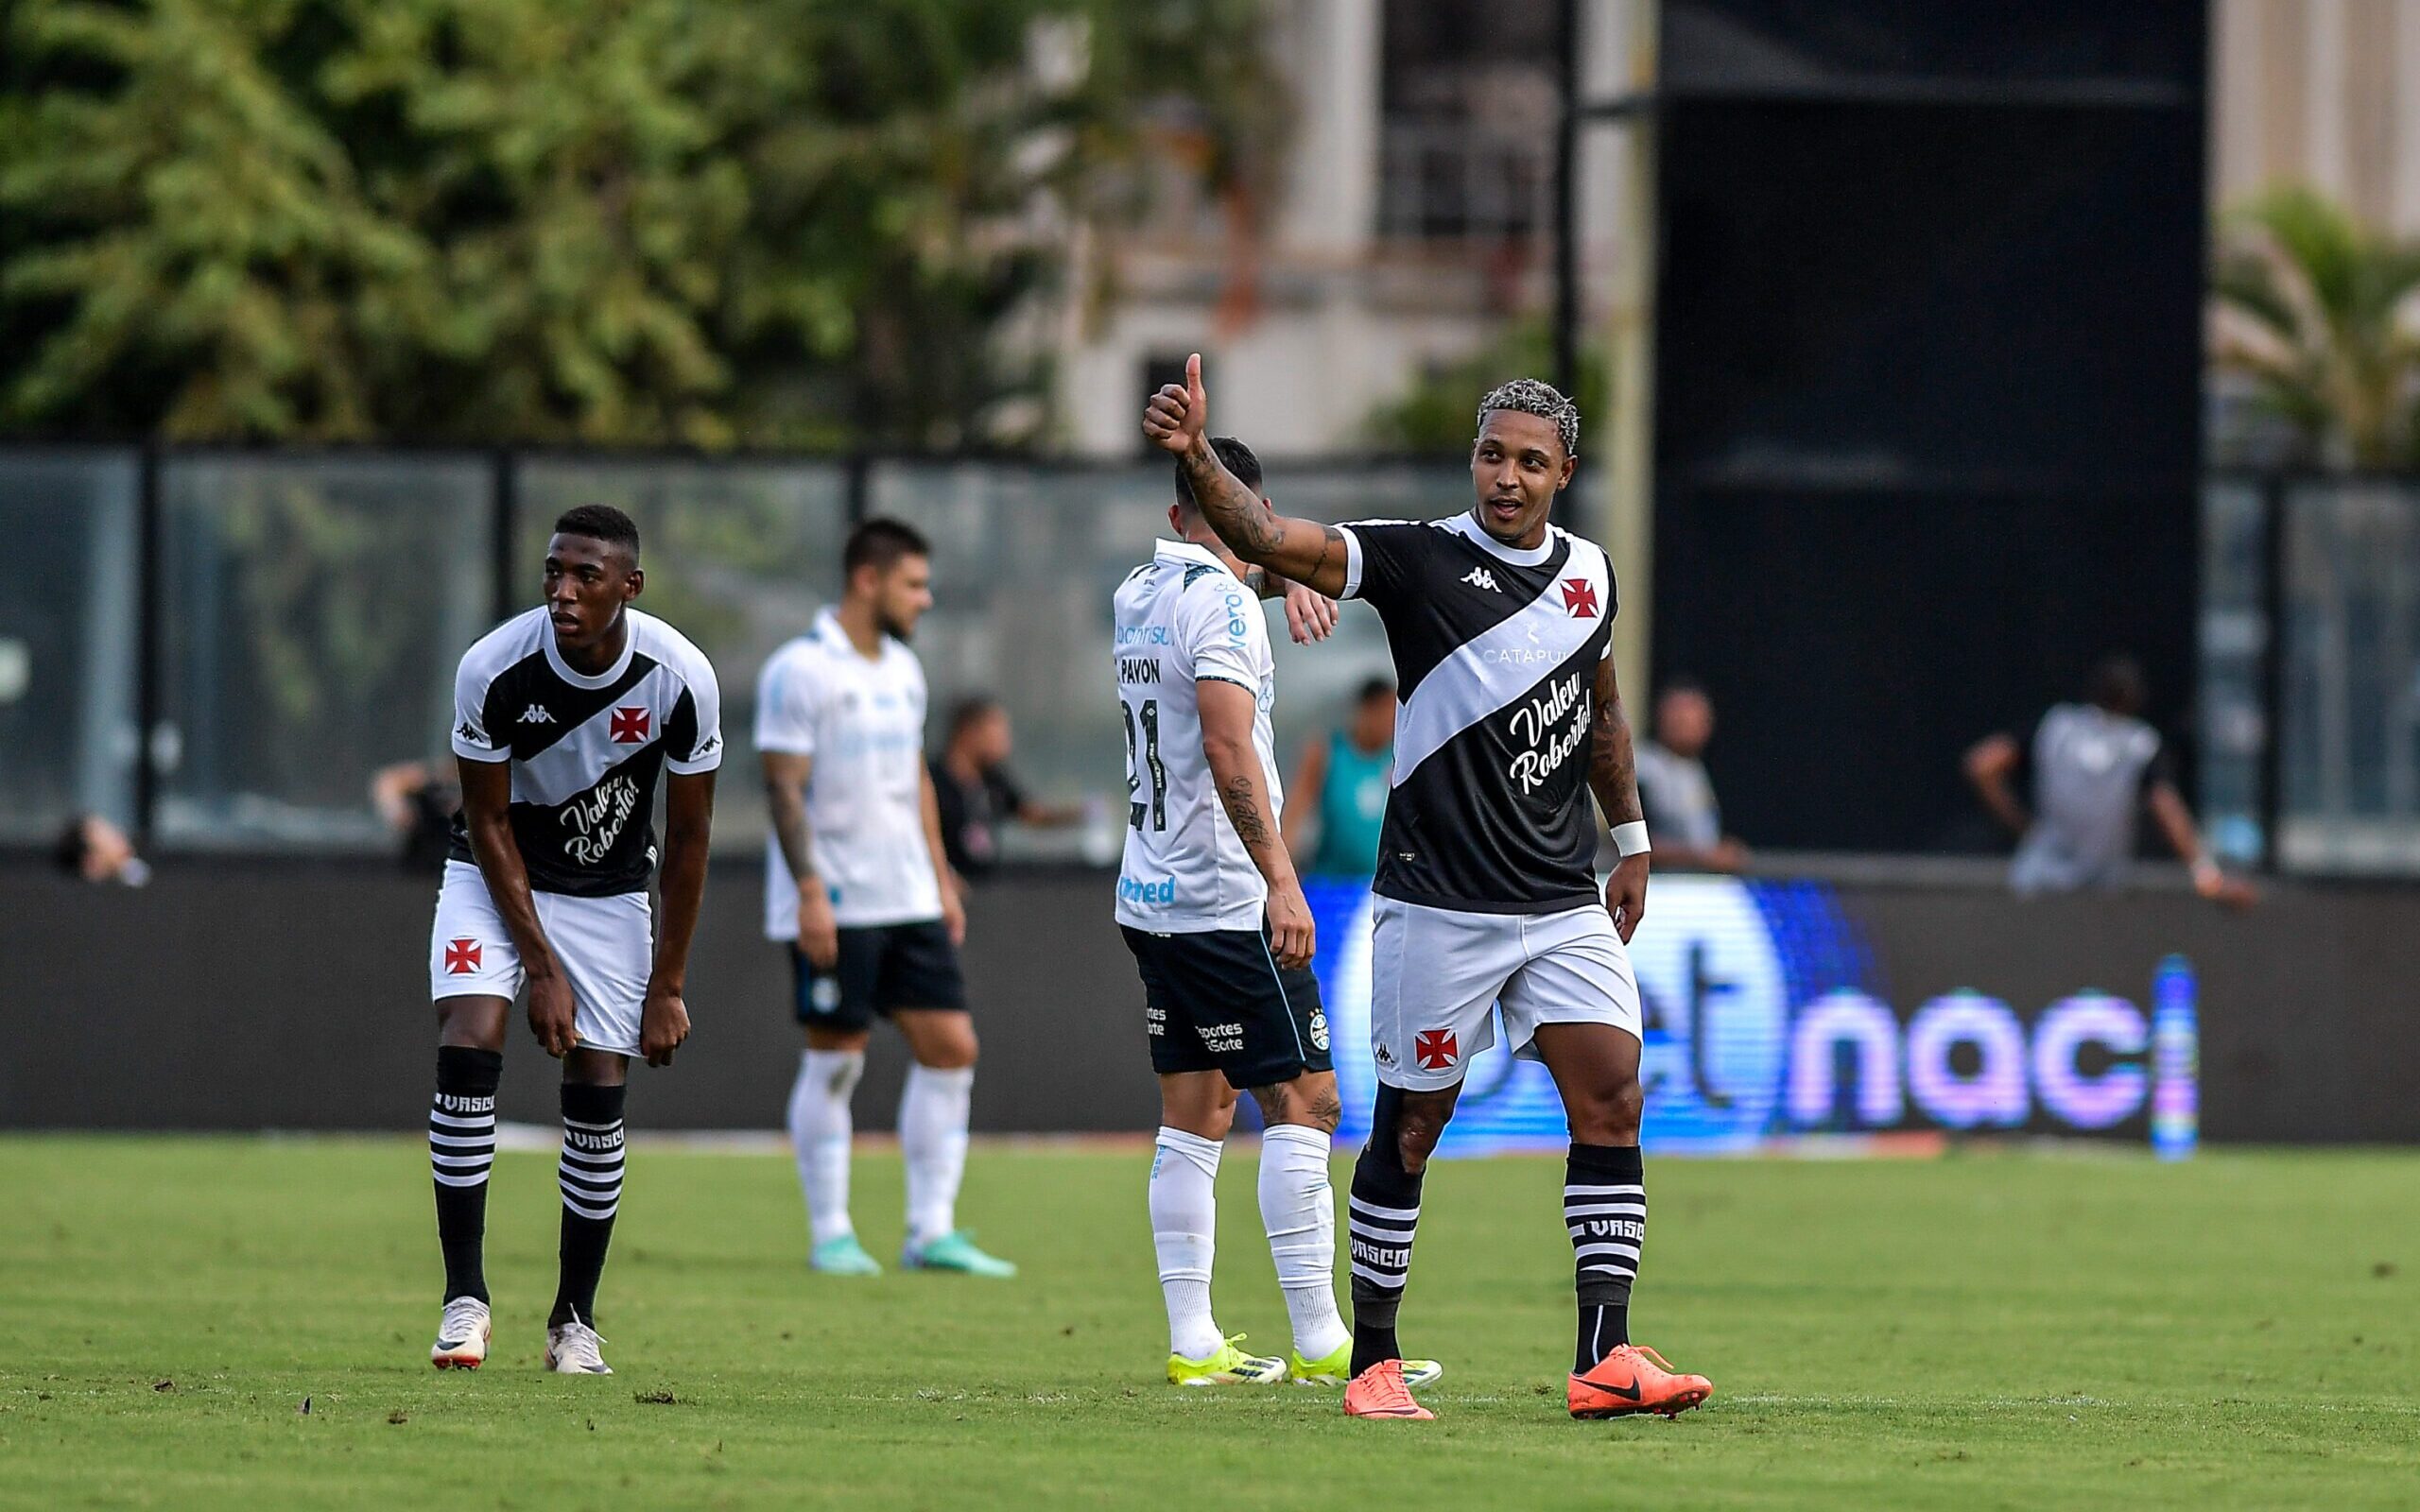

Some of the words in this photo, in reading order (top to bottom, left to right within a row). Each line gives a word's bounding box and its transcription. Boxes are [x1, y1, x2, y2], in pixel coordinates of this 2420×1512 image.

[1225, 594, 1247, 651] vero
[1121, 658, 1161, 684] PAVON
[1510, 671, 1581, 747] Valeu
[1510, 688, 1591, 795] Roberto!
[564, 776, 640, 866] Roberto!
[1350, 1236, 1410, 1268] VASCO
